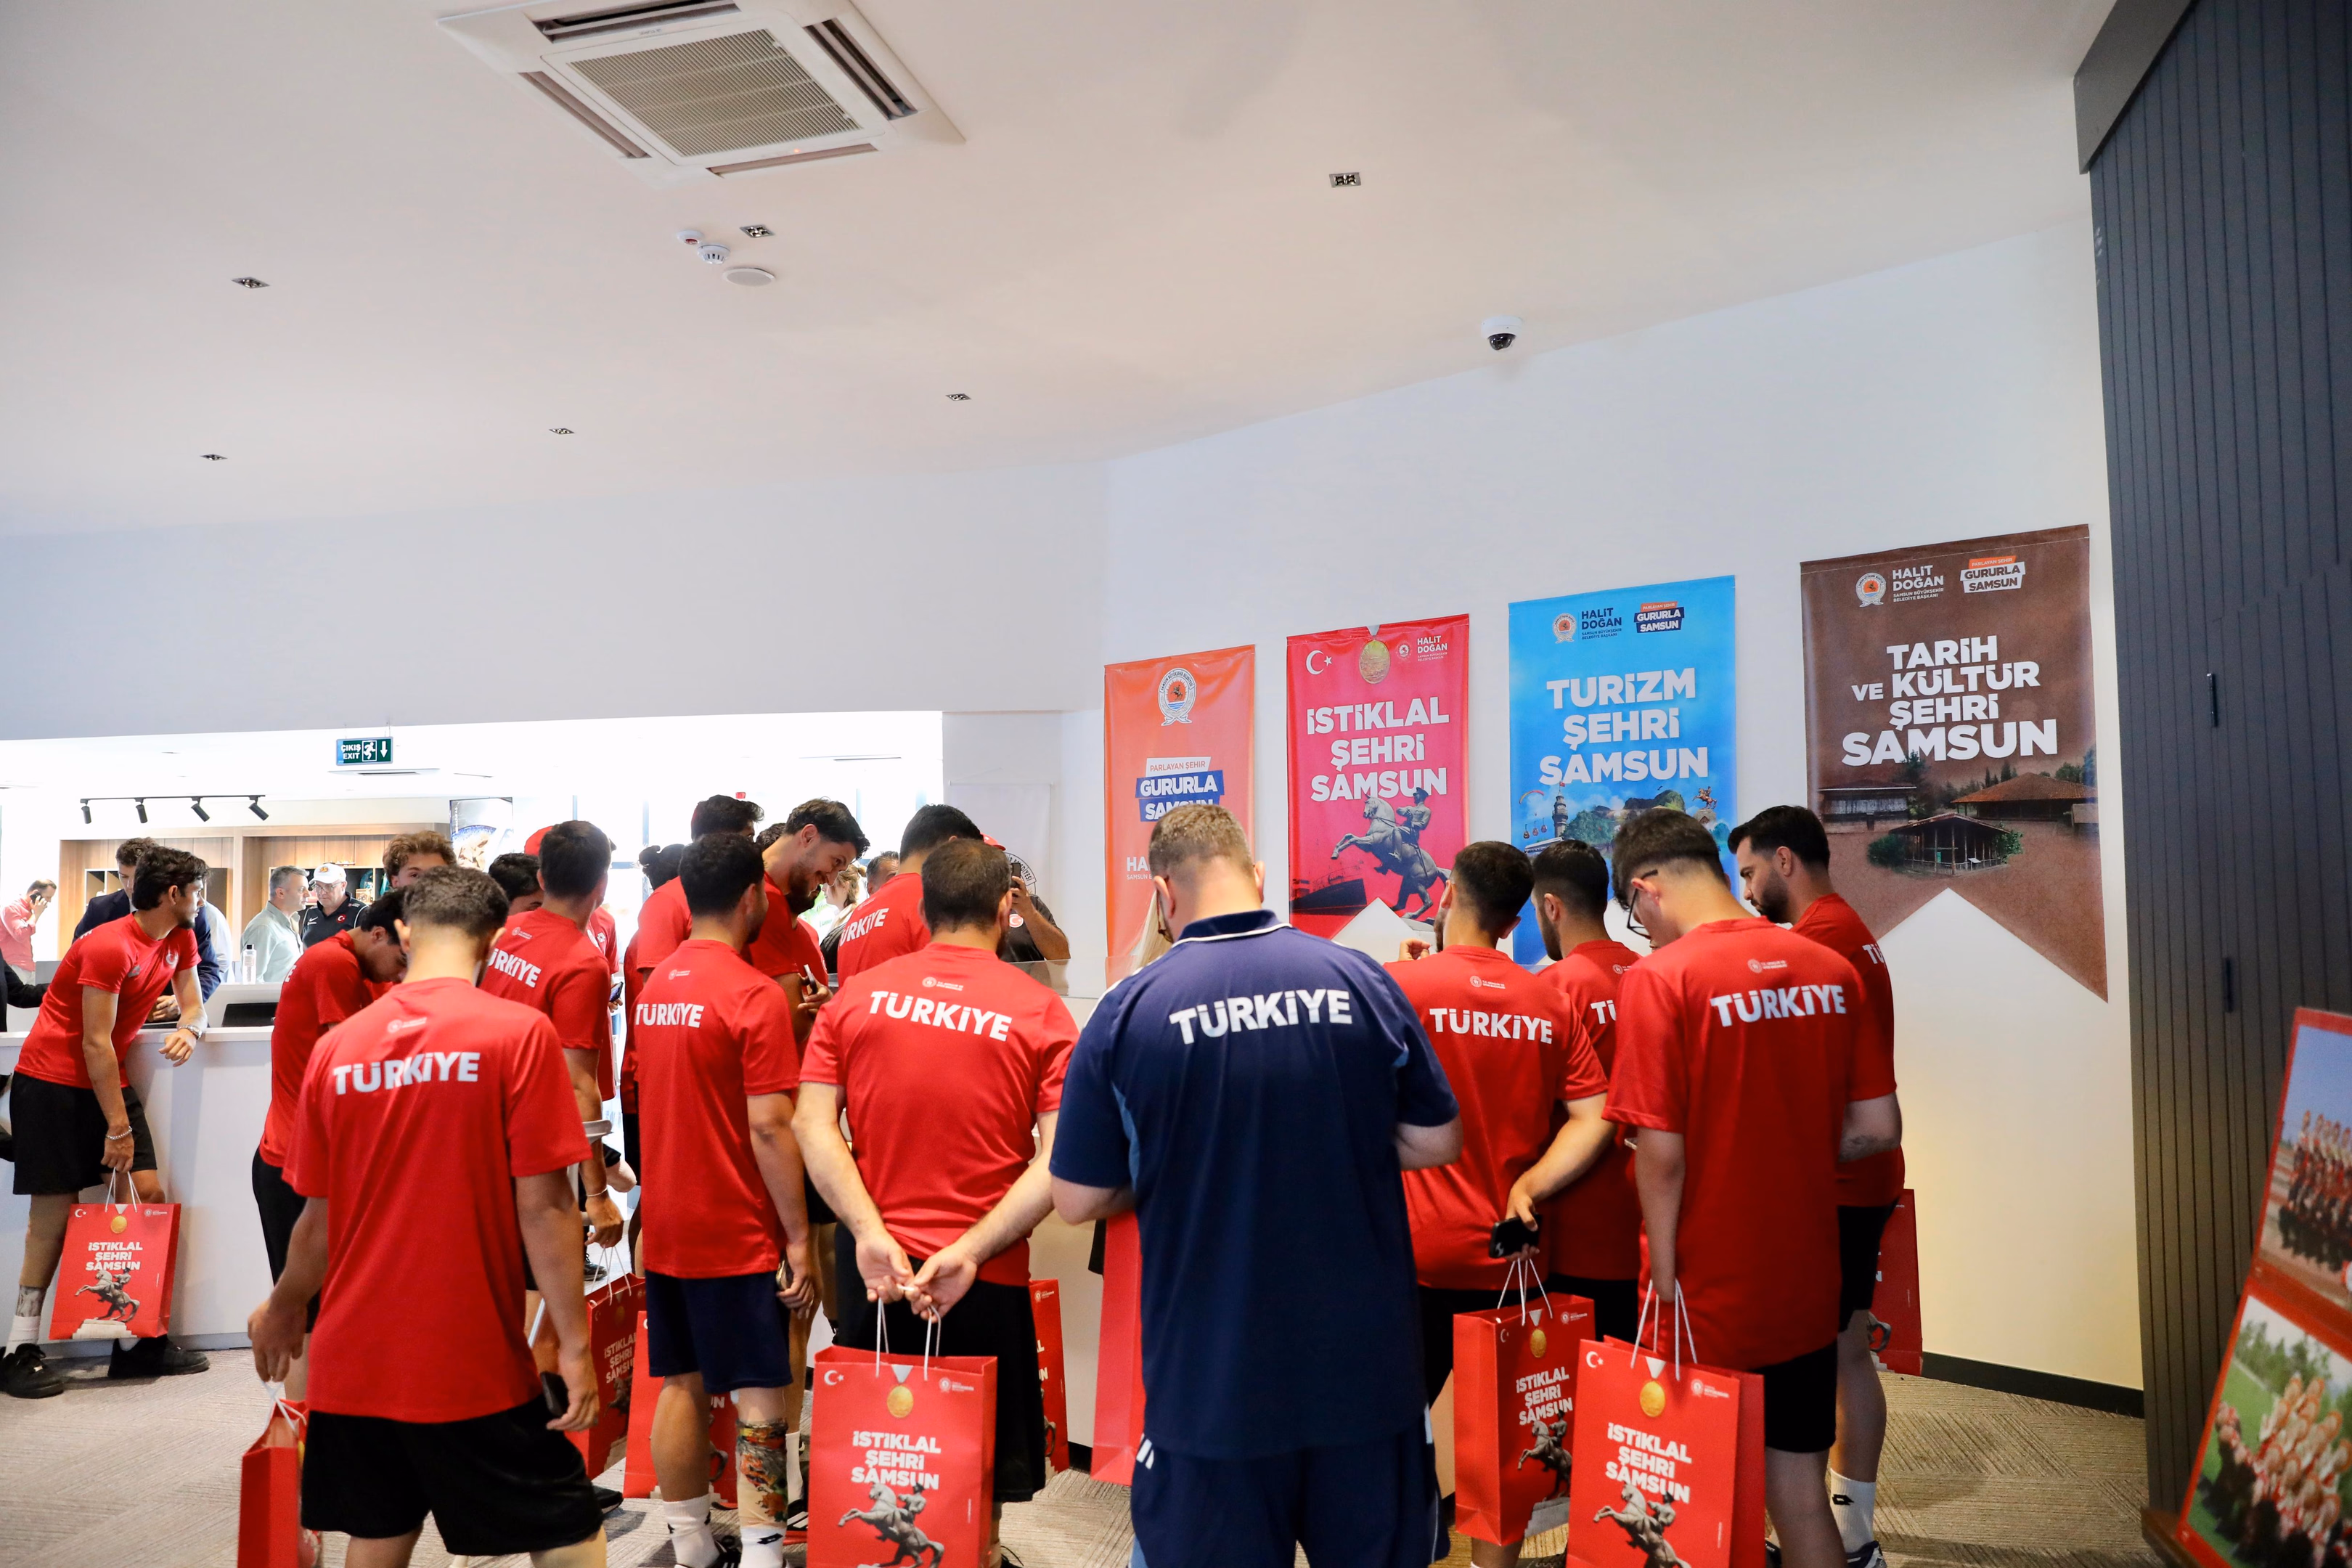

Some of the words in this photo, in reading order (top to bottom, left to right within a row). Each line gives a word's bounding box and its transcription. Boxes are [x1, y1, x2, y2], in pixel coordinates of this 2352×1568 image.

[1892, 565, 1933, 580] HALİT
[1892, 575, 1944, 592] DOĞAN
[1964, 565, 2020, 579] GURURLA
[1969, 577, 2017, 592] SAMSUN
[1582, 608, 1614, 619] HALİT
[1582, 617, 1622, 630] DOĞAN
[1637, 609, 1681, 622] GURURLA
[1640, 620, 1679, 632] SAMSUN
[1417, 636, 1441, 645] HALİT
[1417, 642, 1447, 654] DOĞAN
[1886, 634, 1998, 670] TARİH
[1546, 667, 1696, 709] TURİZM
[1851, 682, 1884, 701] VE
[1892, 661, 2041, 698] KÜLTÜR
[1307, 696, 1450, 735] İSTİKLAL
[1889, 693, 1998, 731] ŞEHRİ
[1562, 707, 1679, 751] ŞEHRİ
[340, 743, 361, 753] ÇIKIŞ
[1330, 733, 1425, 772] ŞEHRİ
[1841, 719, 2058, 767] SAMSUN
[1150, 762, 1184, 772] PARLAYAN
[1539, 746, 1708, 785] SAMSUN
[1140, 775, 1218, 797] GURURLA
[1310, 767, 1447, 802] SAMSUN
[488, 948, 542, 988] ÜRKİYE
[635, 1003, 704, 1029] TÜRKİYE
[870, 990, 1013, 1042] TÜRKİYE
[1169, 988, 1352, 1045] TÜRKİYE
[1710, 984, 1847, 1027] TÜRKİYE
[1429, 1008, 1553, 1045] TÜRKİYE
[333, 1051, 481, 1095] TÜRKİYE
[88, 1241, 143, 1251] İSTİKLAL
[94, 1251, 132, 1262] ŞEHRİ
[86, 1261, 141, 1270] SAMSUN
[1516, 1366, 1569, 1393] İSTİKLAL
[1524, 1384, 1561, 1409] ŞEHRİ
[1519, 1397, 1573, 1426] SAMSUN
[852, 1430, 942, 1454] İSTİKLAL
[1607, 1422, 1692, 1464] İSTİKLAL
[865, 1450, 925, 1470] ŞEHRİ
[1617, 1445, 1675, 1479] ŞEHRİ
[851, 1466, 939, 1490] SAMSUN
[1605, 1461, 1691, 1504] SAMSUN
